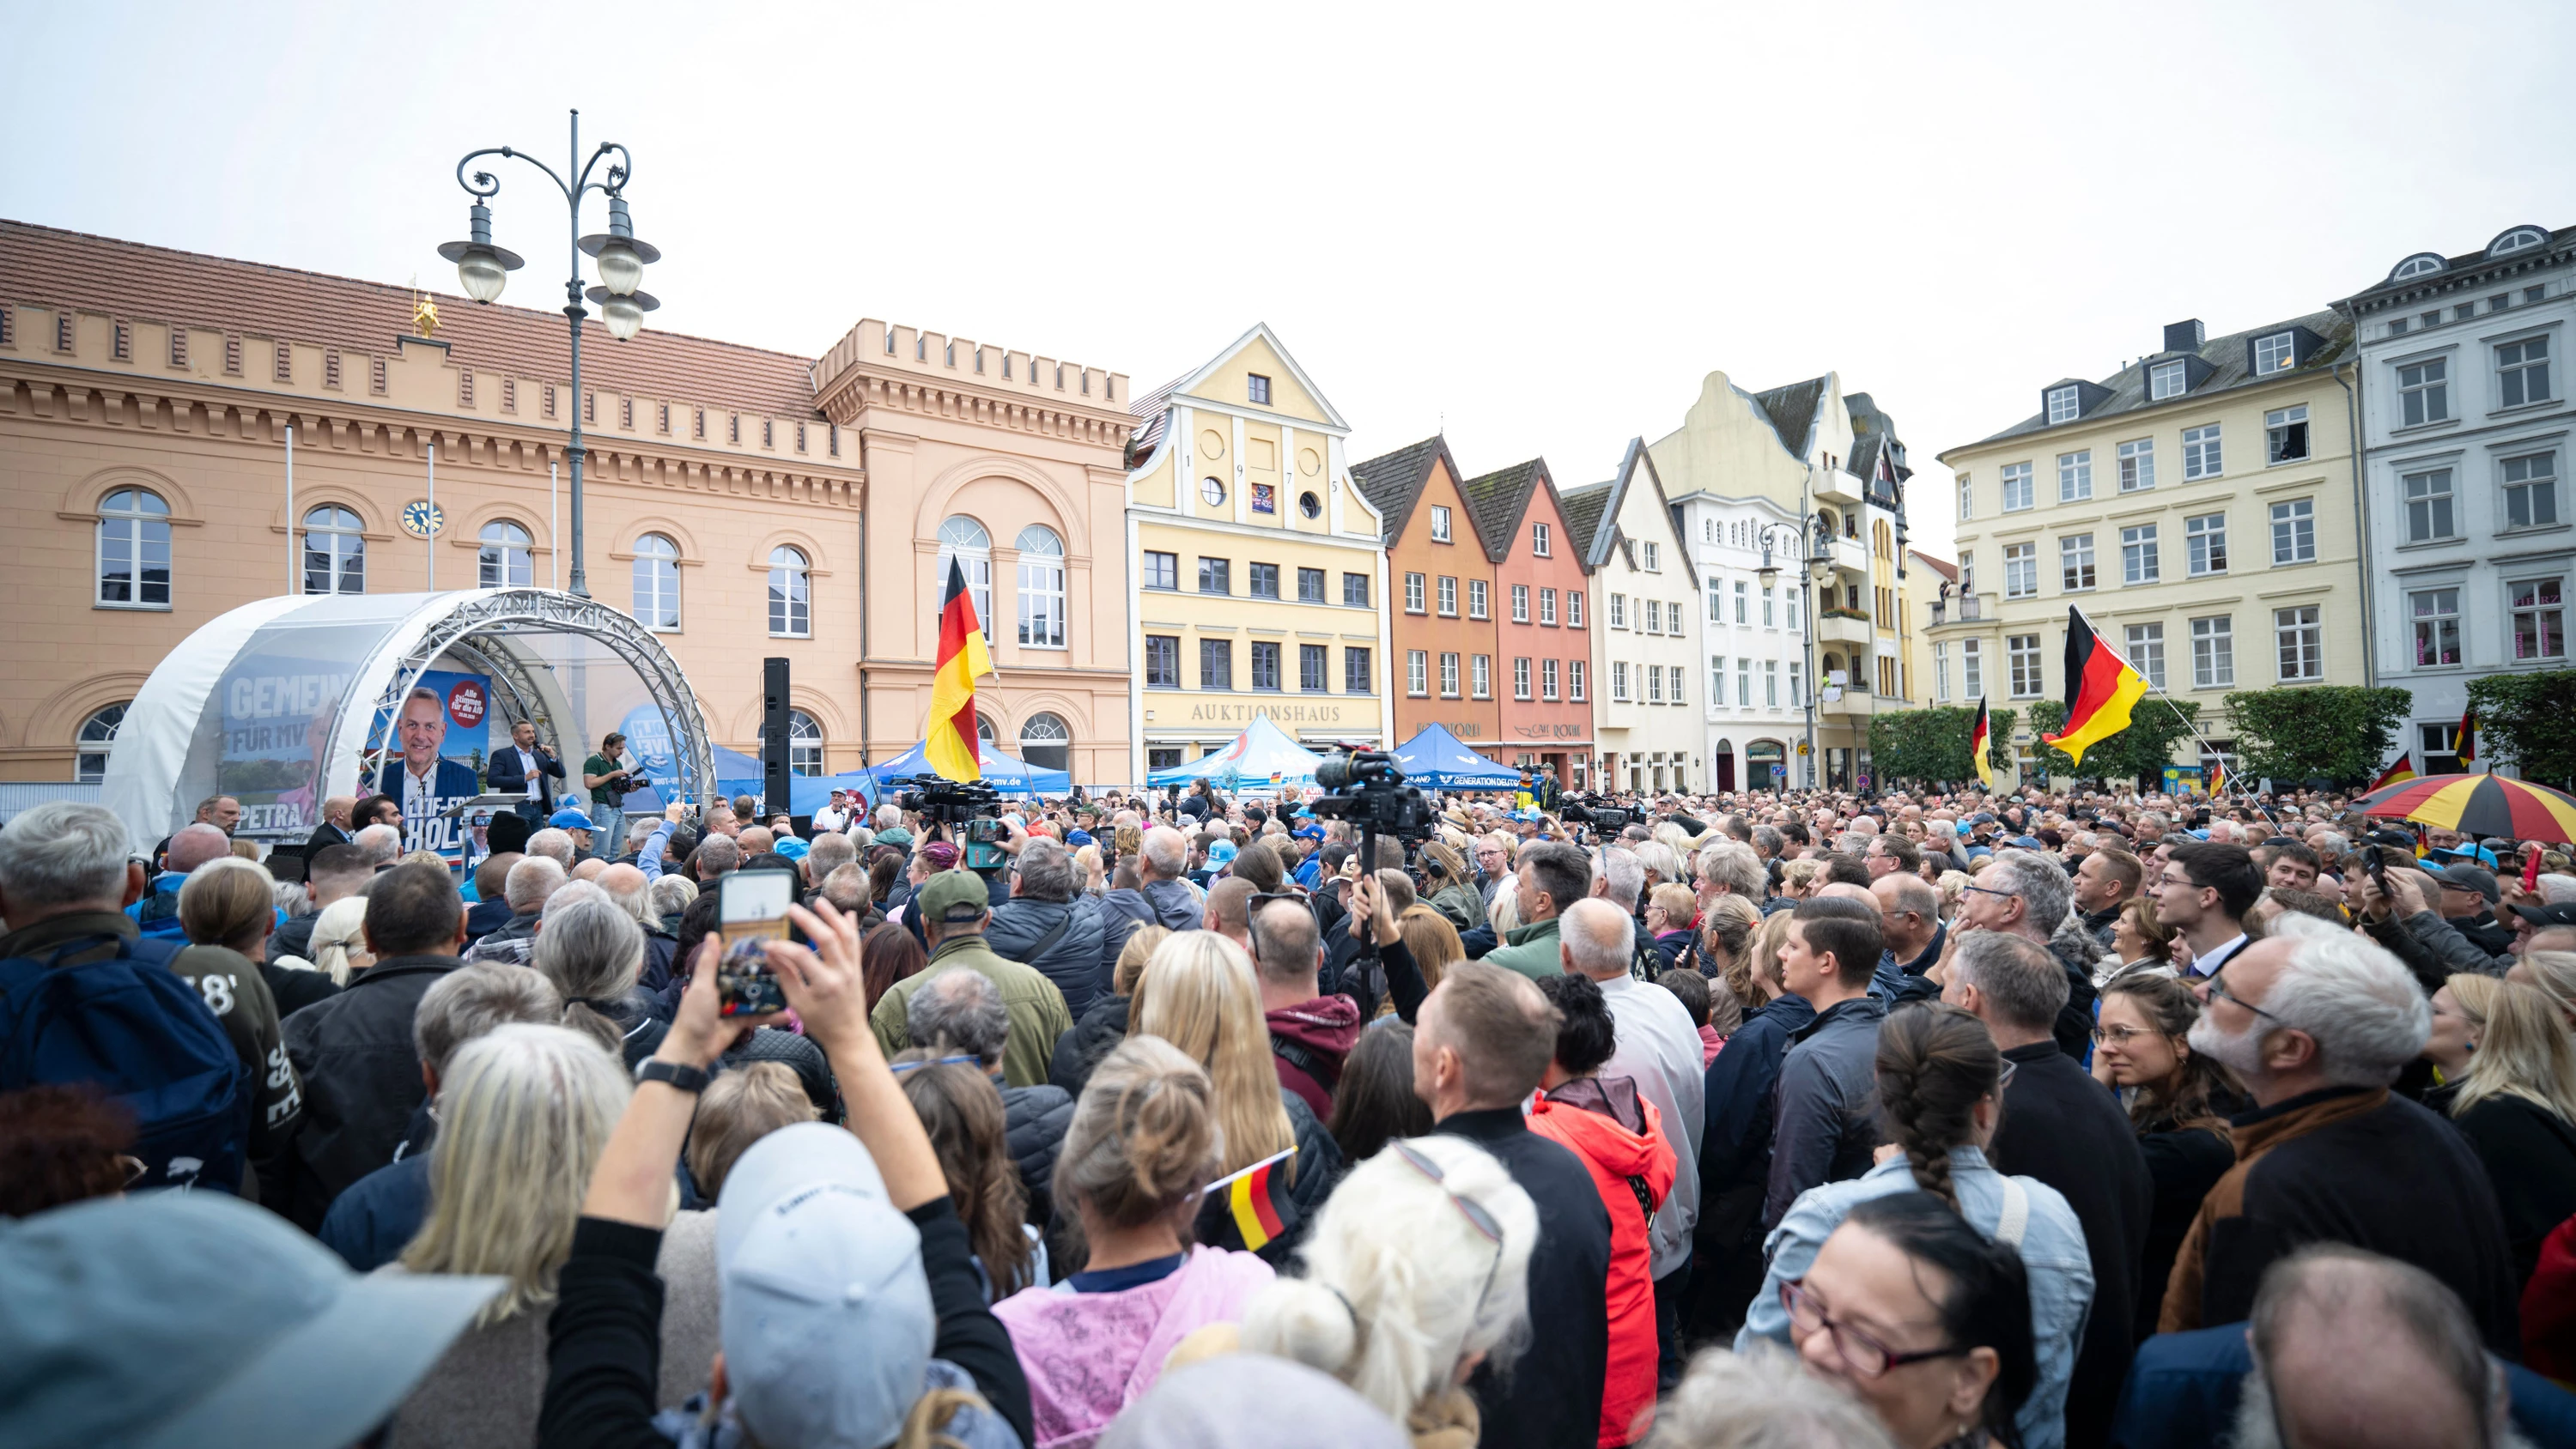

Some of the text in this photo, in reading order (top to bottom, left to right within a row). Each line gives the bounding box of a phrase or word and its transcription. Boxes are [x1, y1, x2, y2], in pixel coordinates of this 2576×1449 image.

[1186, 455, 1338, 493] 1 9 7 5
[2514, 595, 2560, 606] HERZ
[465, 688, 477, 698] Alle
[454, 694, 482, 706] Stimmen
[472, 706, 483, 715] AfD
[1192, 704, 1340, 721] AUKTIONSHAUS
[1417, 722, 1480, 737] KOITOREI
[233, 721, 306, 754] FÜR MV
[1454, 777, 1497, 786] GENERATION
[404, 816, 463, 852] HOL
